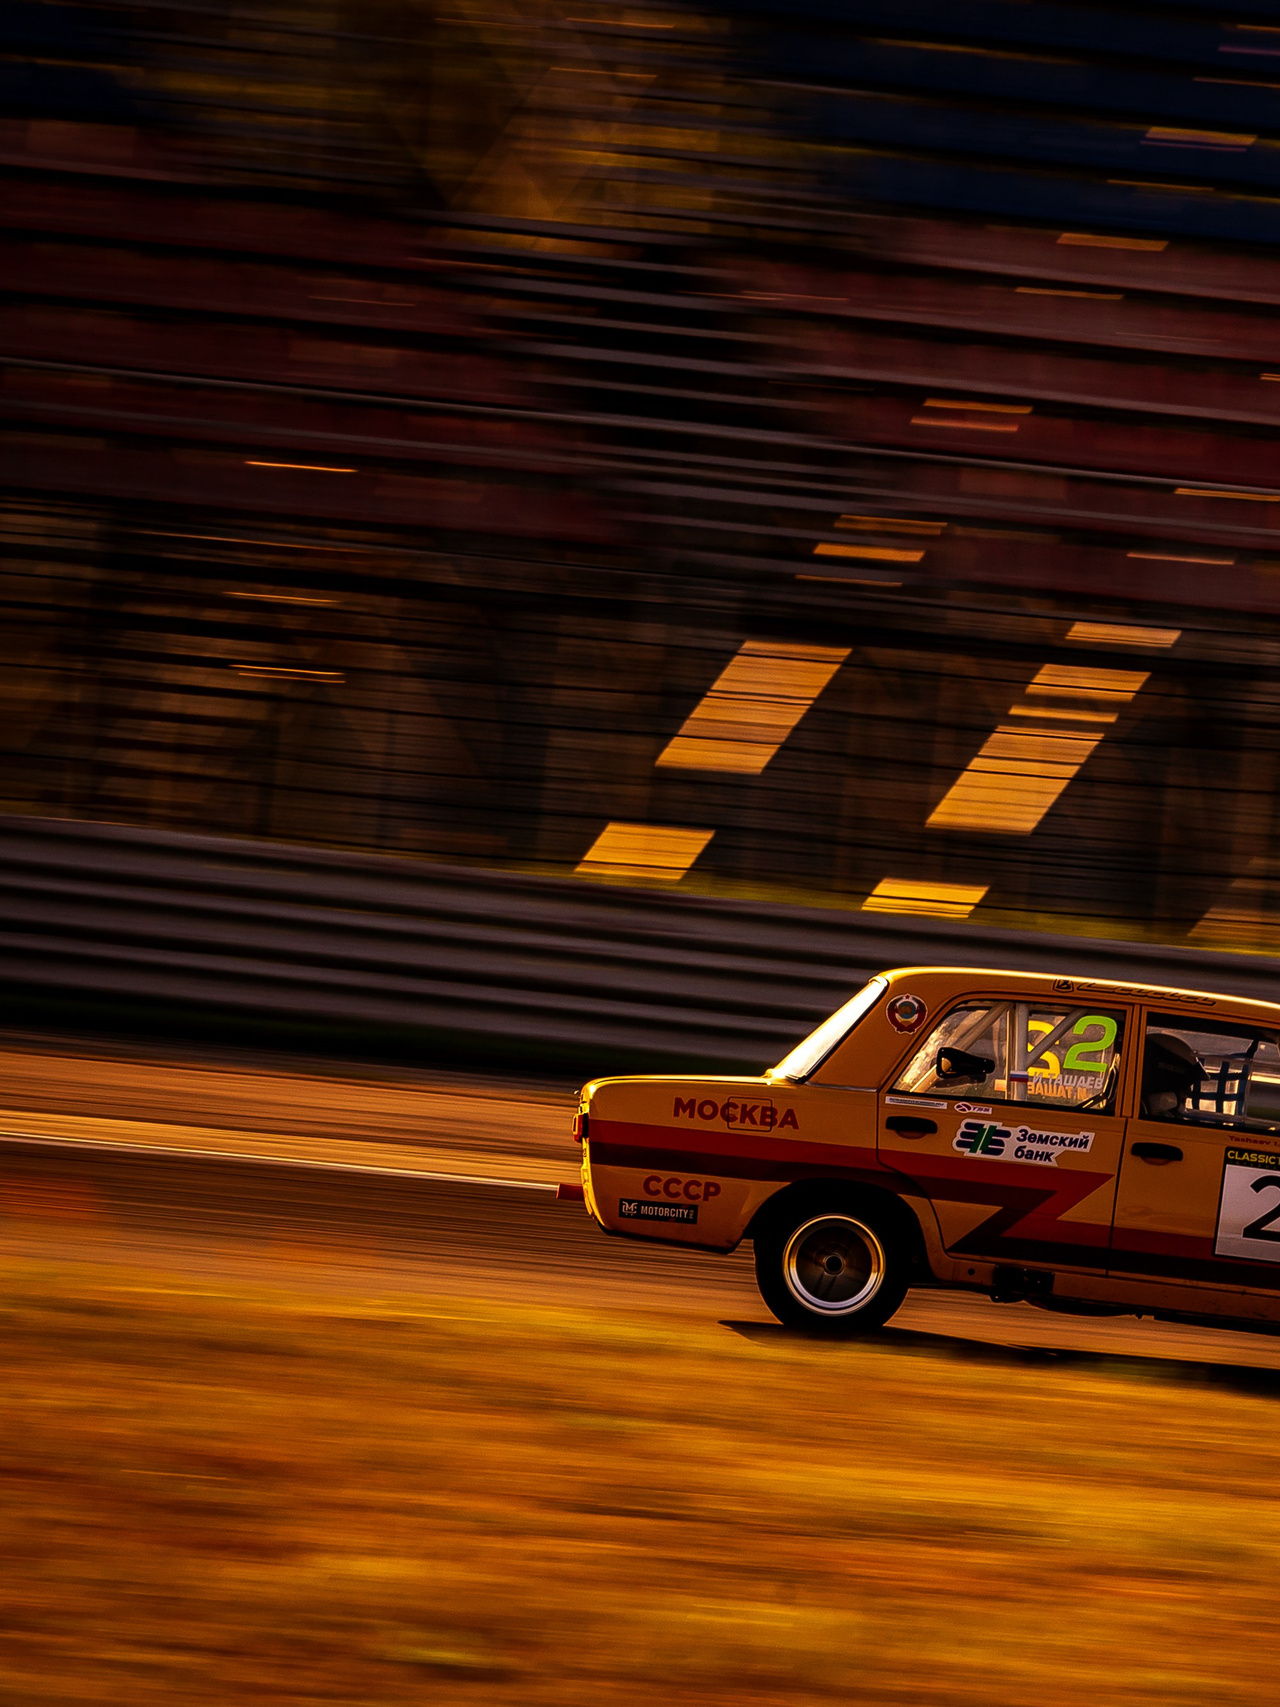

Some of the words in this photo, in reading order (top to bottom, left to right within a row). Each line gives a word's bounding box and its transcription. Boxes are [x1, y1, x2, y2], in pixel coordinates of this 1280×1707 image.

[1063, 1015, 1117, 1072] 2
[673, 1097, 799, 1130] МОСКВА
[1016, 1129, 1090, 1149] Земский
[1014, 1146, 1055, 1162] банк
[643, 1175, 721, 1202] СССР
[641, 1206, 689, 1219] MOTORCITY
